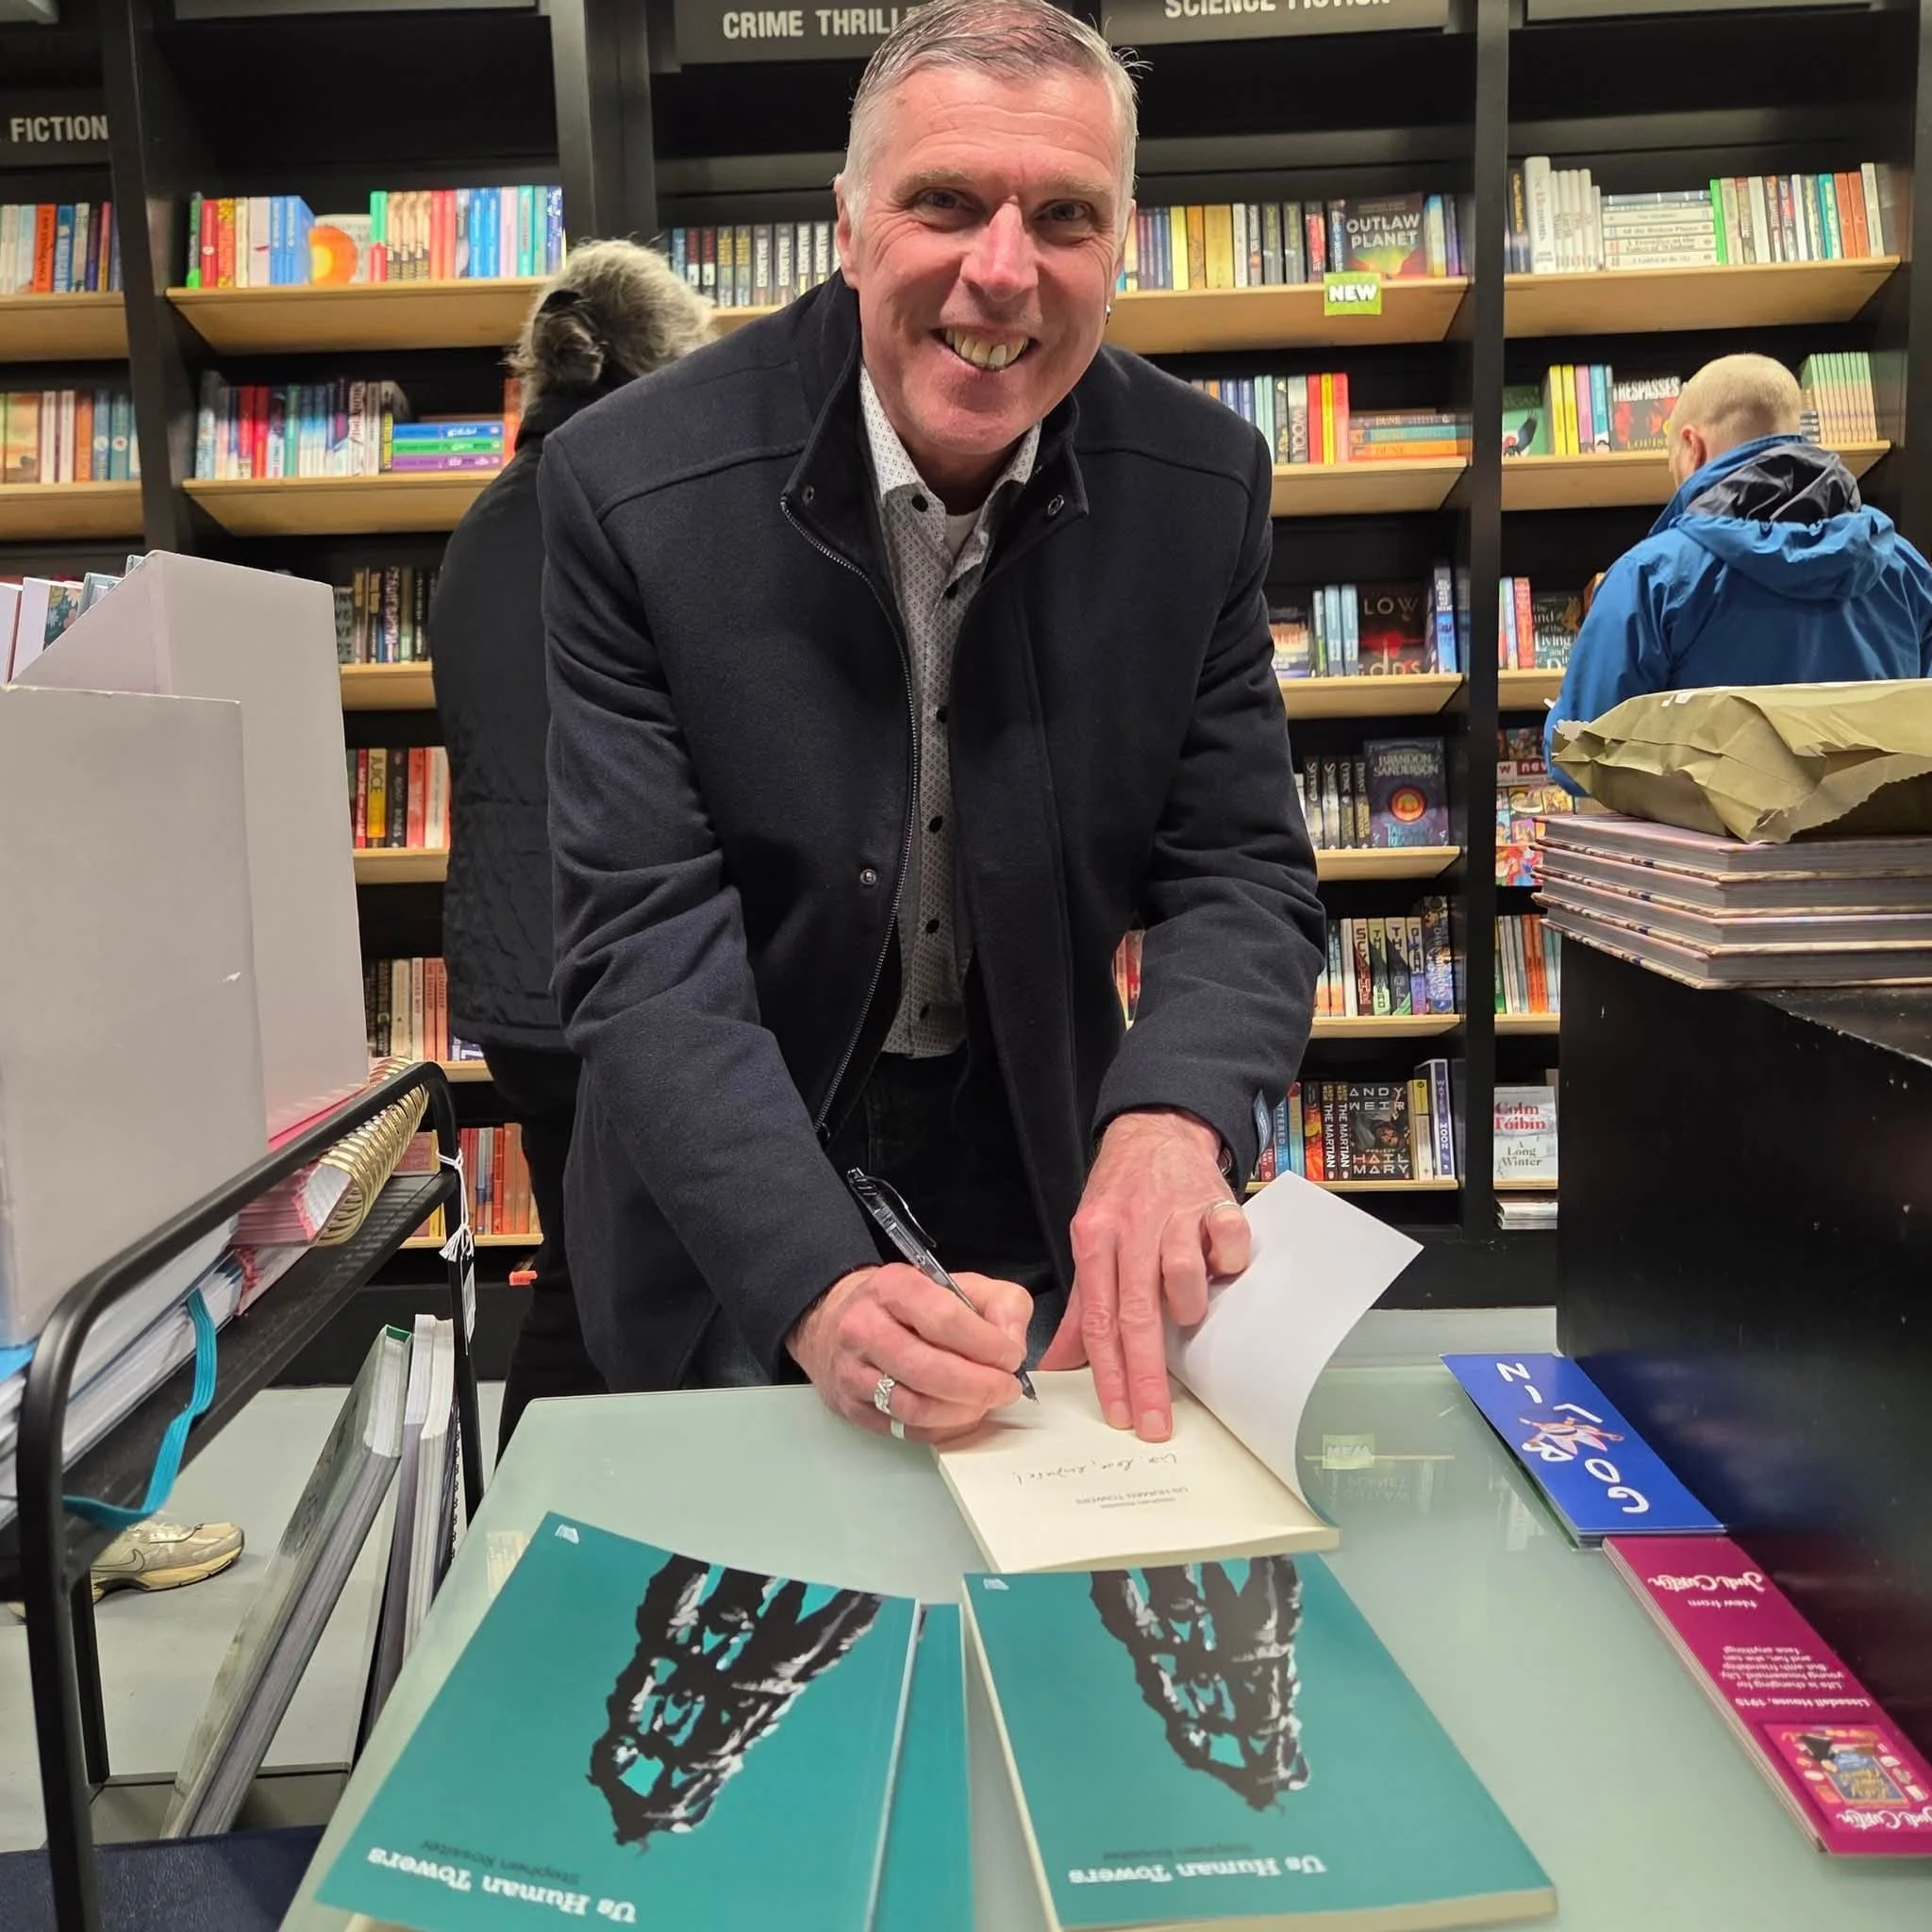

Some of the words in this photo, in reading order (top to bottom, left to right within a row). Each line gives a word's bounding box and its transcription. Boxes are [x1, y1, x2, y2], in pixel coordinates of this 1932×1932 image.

[723, 10, 804, 39] CRIME
[815, 8, 919, 37] THRILL
[10, 115, 108, 143] FICTION
[1346, 212, 1422, 234] OUTLAW
[1351, 230, 1418, 249] PLANET
[1328, 283, 1377, 302] NEW
[1613, 376, 1681, 402] TRESPASSES
[1627, 438, 1669, 450] LOUIS
[1534, 631, 1572, 652] Living
[1378, 754, 1432, 765] BRANDON
[370, 756, 383, 793] JUICE
[1374, 763, 1440, 777] SANDERSON
[1349, 1088, 1404, 1100] ANDY
[1324, 1104, 1334, 1123] THE
[1339, 1103, 1348, 1123] THE
[1349, 1102, 1405, 1110] WEIR
[1495, 1102, 1539, 1115] Colm
[1276, 1101, 1285, 1144] TTERED
[1495, 1116, 1547, 1130] Tóibín
[1440, 1122, 1449, 1150] MOON
[1324, 1124, 1336, 1168] MARTIAN
[1339, 1124, 1350, 1168] MARTIAN
[1507, 1146, 1536, 1157] Long
[1353, 1154, 1409, 1163] HAIL
[1502, 1157, 1542, 1167] Winter
[1354, 1164, 1409, 1174] MARY
[1688, 1598, 1723, 1609] from
[1724, 1599, 1758, 1609] New
[1754, 1679, 1806, 1690] changing
[1808, 1671, 1844, 1679] young
[419, 1840, 495, 1869] Rossiter
[367, 1846, 472, 1892] Towers
[501, 1859, 580, 1886] Stephen
[1175, 1857, 1282, 1878] Human
[1285, 1855, 1327, 1874] Us
[1068, 1864, 1174, 1886] Towers
[482, 1874, 591, 1916] Human
[597, 1897, 637, 1924] Us
